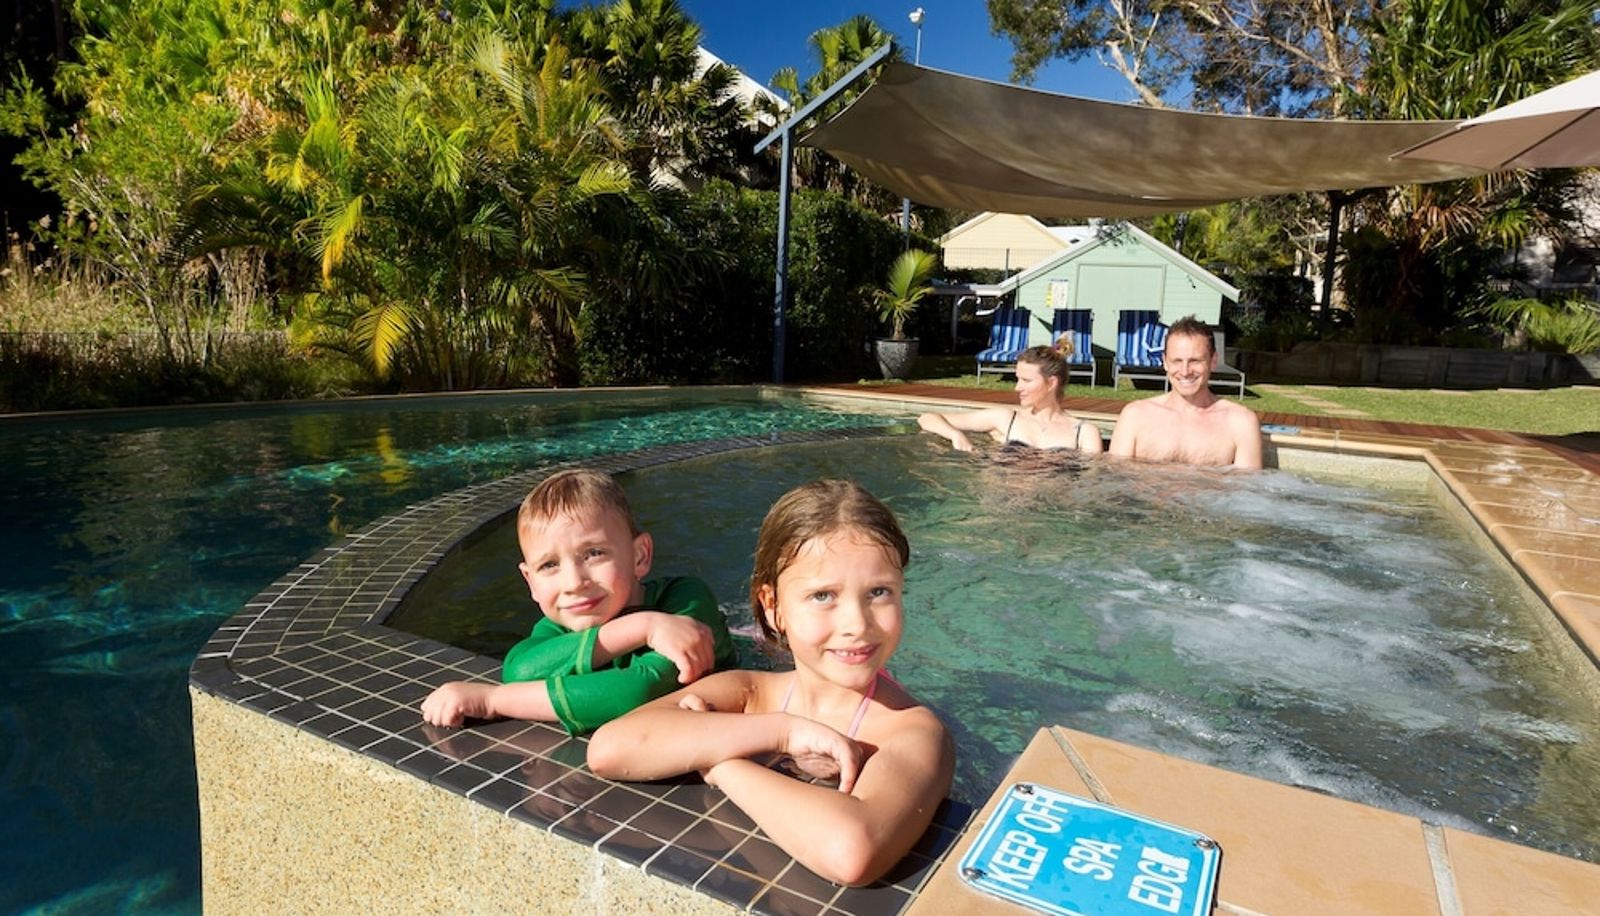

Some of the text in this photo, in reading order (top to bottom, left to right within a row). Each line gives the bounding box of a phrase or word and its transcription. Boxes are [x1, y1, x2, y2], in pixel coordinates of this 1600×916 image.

[987, 794, 1069, 890] KEEP OFF
[1062, 837, 1122, 881] SPA
